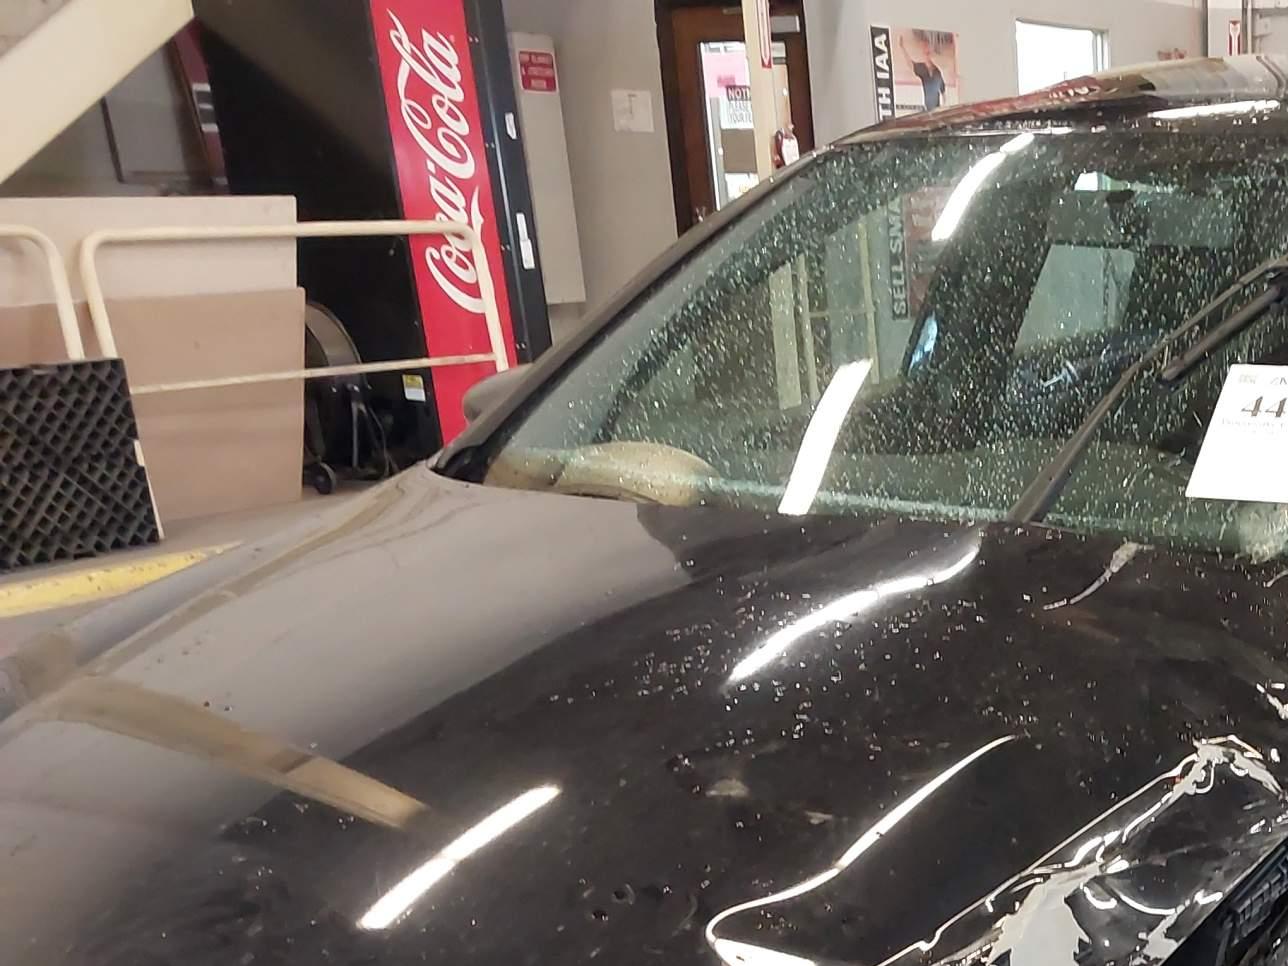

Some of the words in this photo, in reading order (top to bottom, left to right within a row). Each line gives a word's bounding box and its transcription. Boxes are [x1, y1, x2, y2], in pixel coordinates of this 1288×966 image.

[874, 33, 890, 80] IAA
[728, 87, 751, 99] NOTI
[877, 86, 892, 121] TH
[386, 8, 487, 315] Coca-Cola
[888, 197, 903, 254] SMA
[892, 259, 906, 315] SELL
